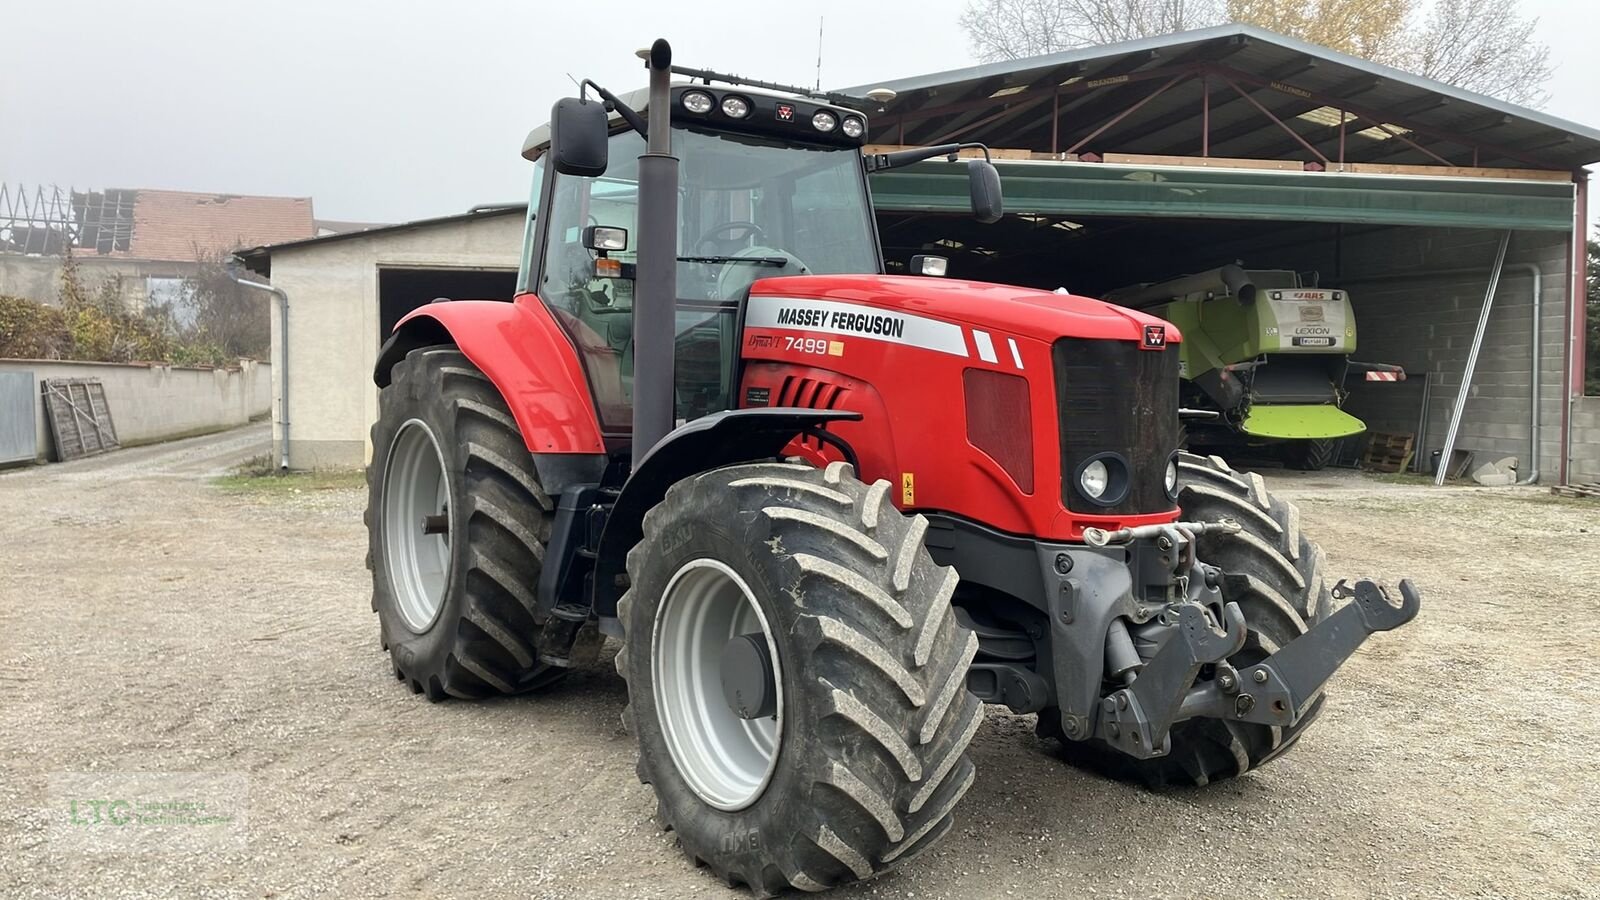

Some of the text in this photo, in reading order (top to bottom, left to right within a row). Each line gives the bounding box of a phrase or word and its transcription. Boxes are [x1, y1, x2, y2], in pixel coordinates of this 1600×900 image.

[777, 308, 904, 338] MASSEY FERGUSON
[1295, 327, 1330, 335] LEXION
[785, 336, 826, 354] 7499
